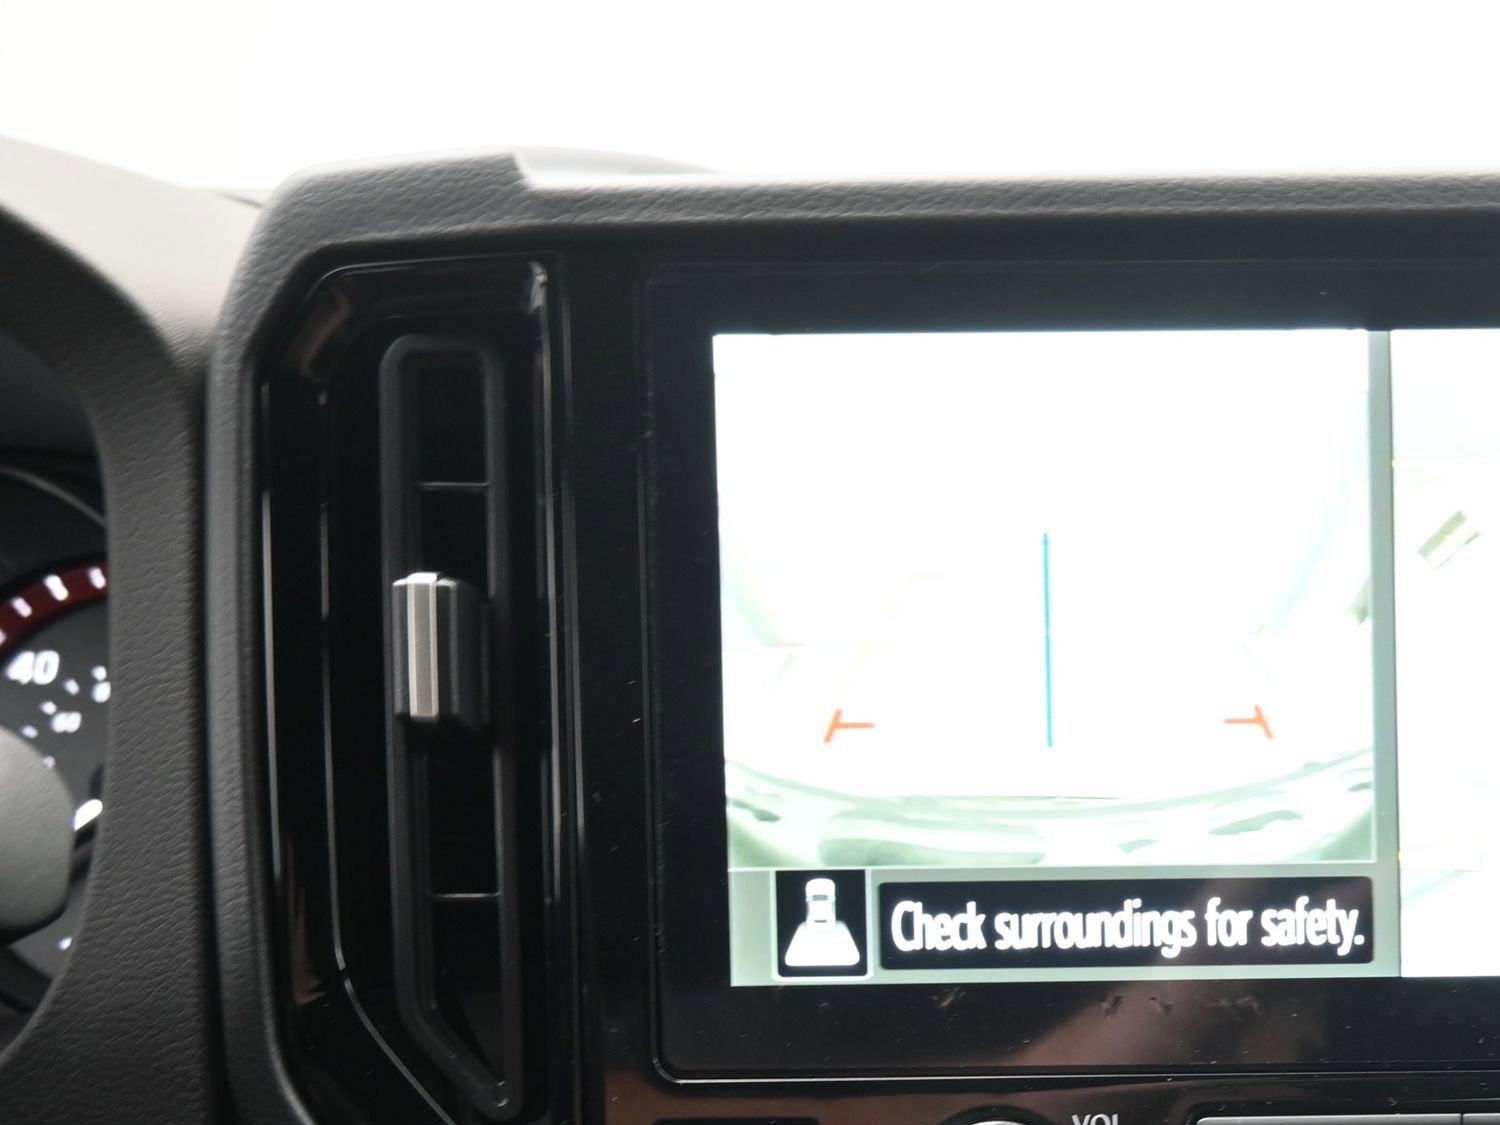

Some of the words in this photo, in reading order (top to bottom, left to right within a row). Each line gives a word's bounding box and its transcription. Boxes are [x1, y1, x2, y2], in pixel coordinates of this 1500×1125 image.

[5, 650, 60, 686] 40
[891, 900, 987, 952] Check
[994, 898, 1198, 959] surroundings
[1204, 897, 1254, 948] for
[1260, 896, 1366, 957] safety.
